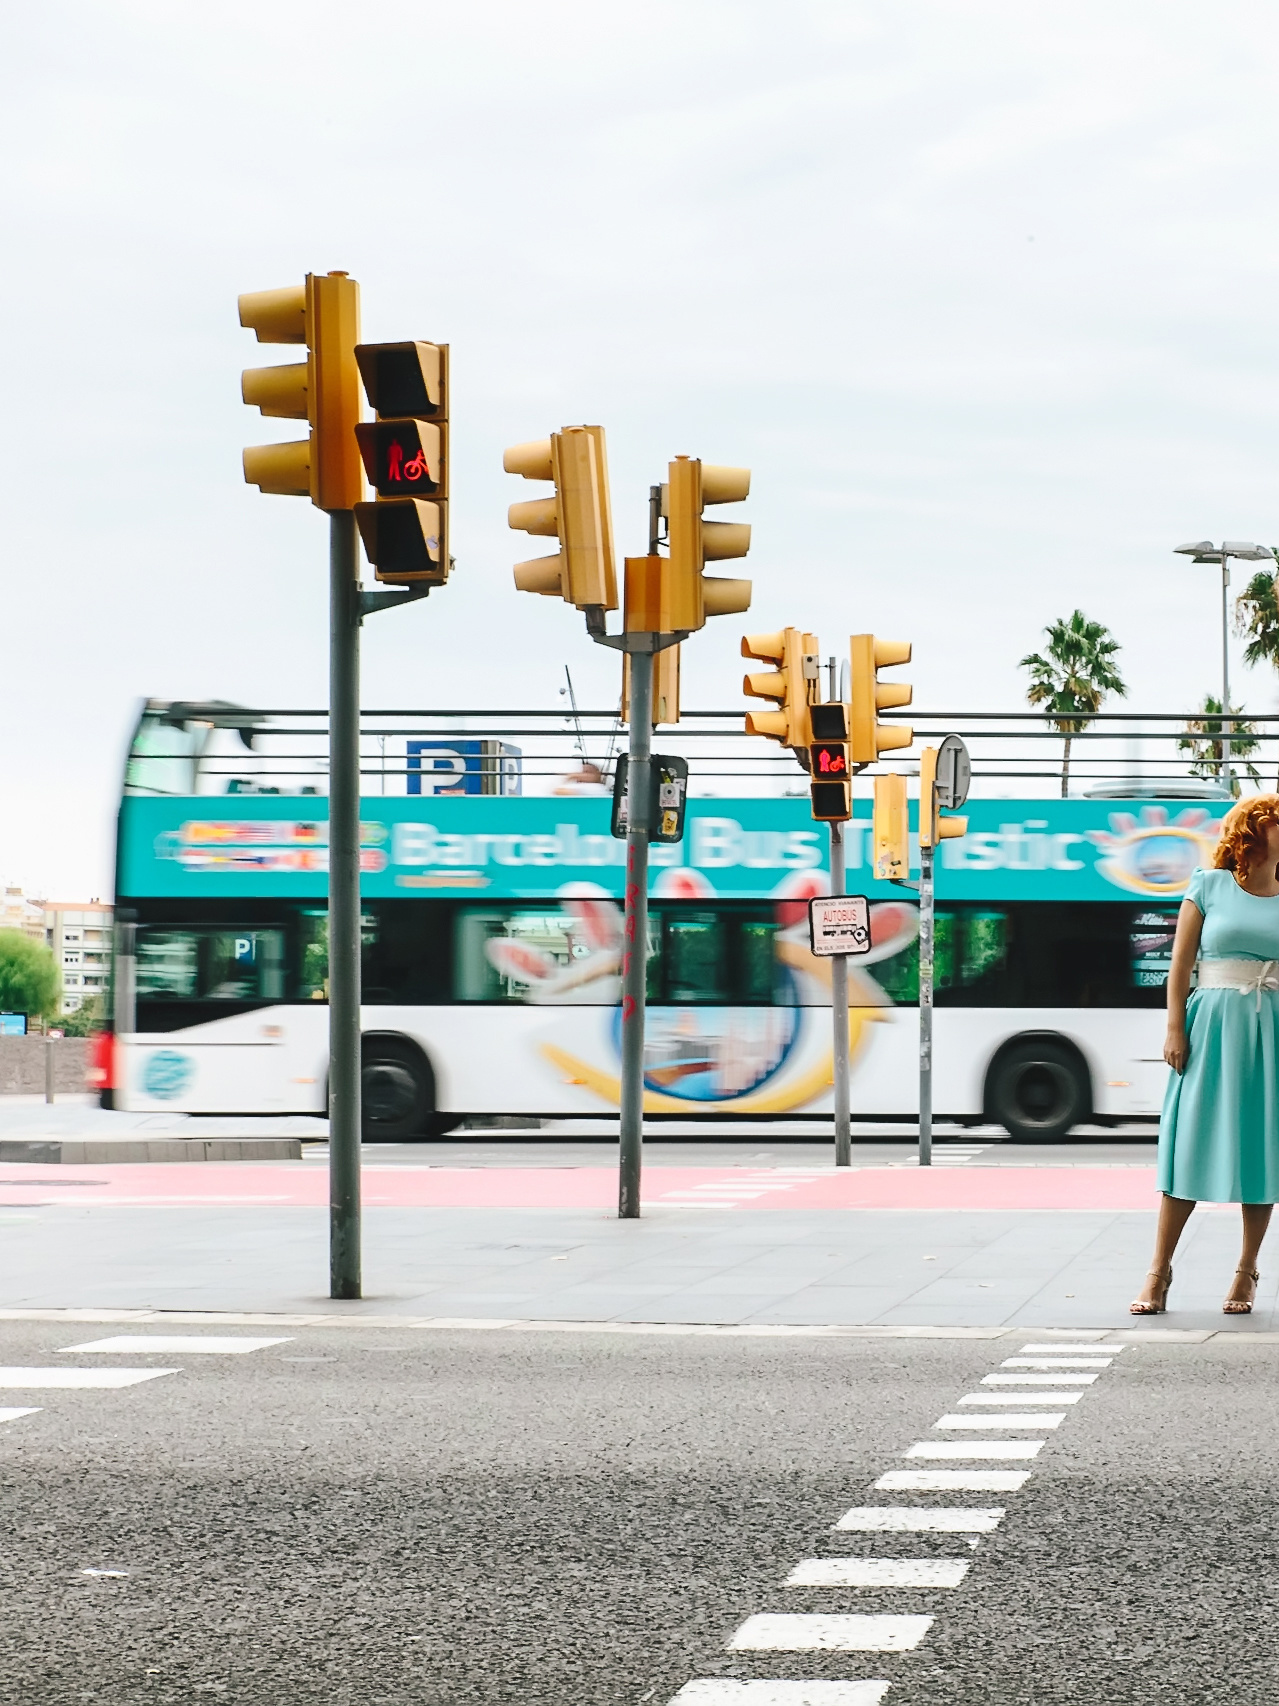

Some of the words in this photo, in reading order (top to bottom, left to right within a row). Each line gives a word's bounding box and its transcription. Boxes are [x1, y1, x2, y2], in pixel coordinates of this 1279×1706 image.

[420, 748, 467, 796] P
[690, 816, 822, 868] Bus
[823, 909, 857, 922] AUTOBUS
[234, 938, 249, 960] P
